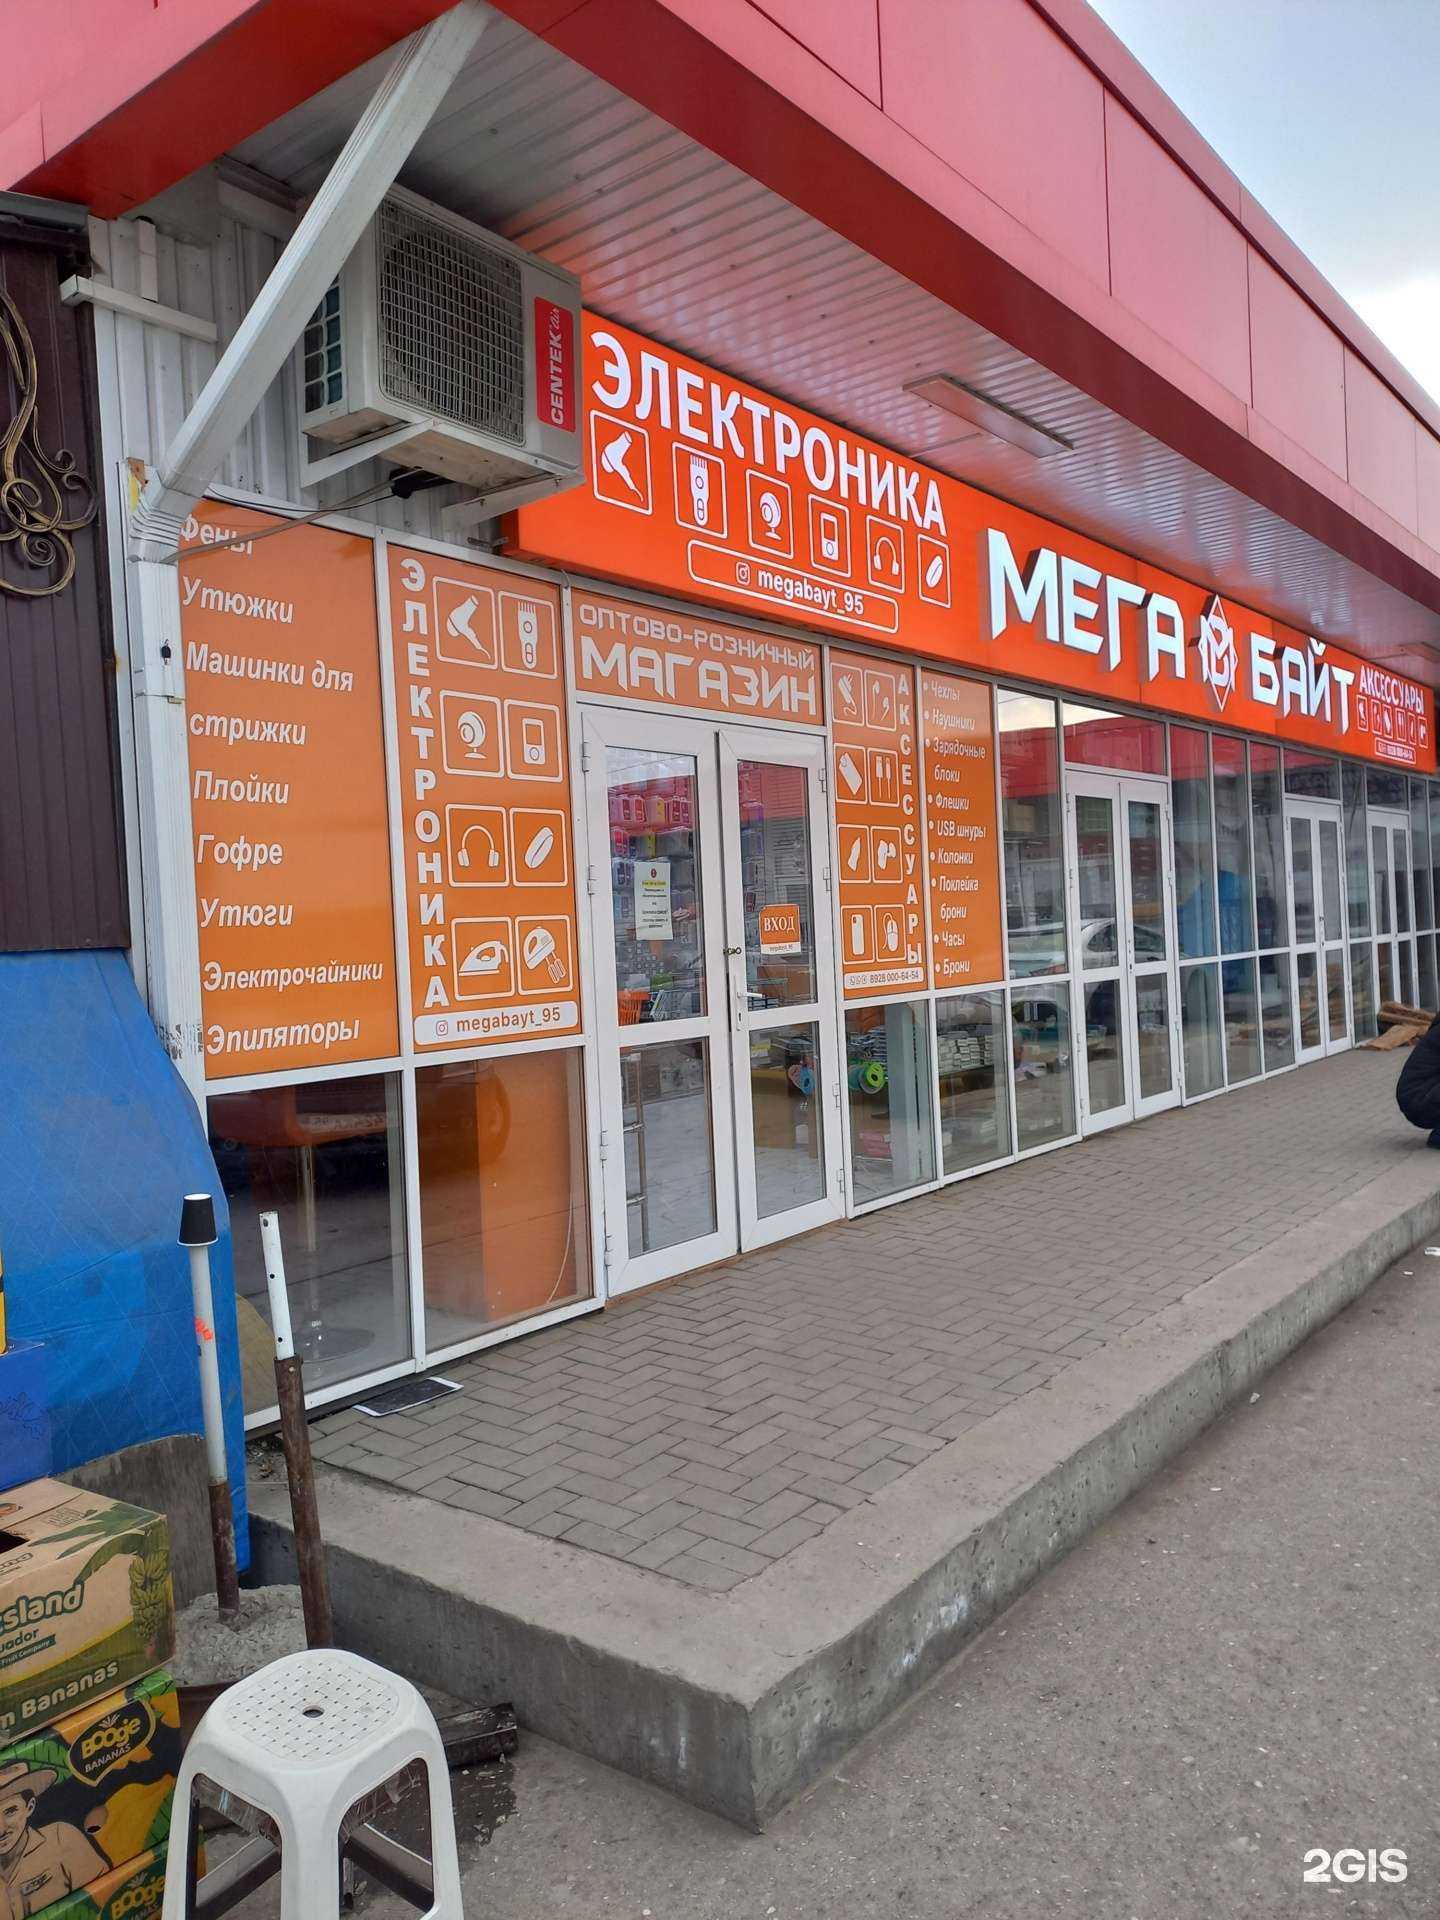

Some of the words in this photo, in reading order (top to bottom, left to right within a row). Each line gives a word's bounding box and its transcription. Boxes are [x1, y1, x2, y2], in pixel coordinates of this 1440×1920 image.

[548, 330, 564, 425] CENTEK
[589, 331, 948, 537] ЭЛЕКТРОНИКА
[182, 575, 294, 624] Утюжки
[757, 568, 865, 616] megabayt_95
[579, 603, 815, 672] ОПТОВО-РОЗНИЧНЫЙ
[986, 527, 1186, 682] МЕГА
[1250, 631, 1355, 736] БАЙТ
[186, 641, 305, 685] Машинки
[311, 659, 354, 692] для
[581, 635, 817, 716] МАГАЗИН
[931, 681, 960, 702] Чехлы
[1360, 664, 1425, 715] АКСЕССУАРЫ
[189, 713, 306, 746] стрижки
[932, 708, 976, 731] Наушники
[933, 736, 986, 759] Зарядочные
[193, 770, 290, 804] Плойки
[400, 558, 450, 1009] ЭЛЕКТРОНИКА
[934, 764, 960, 783] блоки
[935, 792, 970, 811] Флешки
[897, 673, 922, 966] АКСЕССУАРЫ
[937, 820, 955, 836] USB
[957, 825, 986, 841] шнуры
[196, 834, 283, 871] Гофре
[938, 848, 974, 864] Колонки
[939, 875, 979, 892] Поклейка
[200, 898, 294, 928] Утюги
[764, 916, 795, 934] ВХОД
[940, 903, 967, 923] брони
[942, 931, 965, 947] Часы
[203, 960, 384, 992] Электрочайники
[943, 958, 970, 978] Брони
[456, 1006, 561, 1033] megabayt_95
[206, 1019, 360, 1055] Эпиляторы
[0, 1583, 84, 1636] sland
[21, 1660, 119, 1720] Bananas
[84, 1743, 132, 1773] BANANAS
